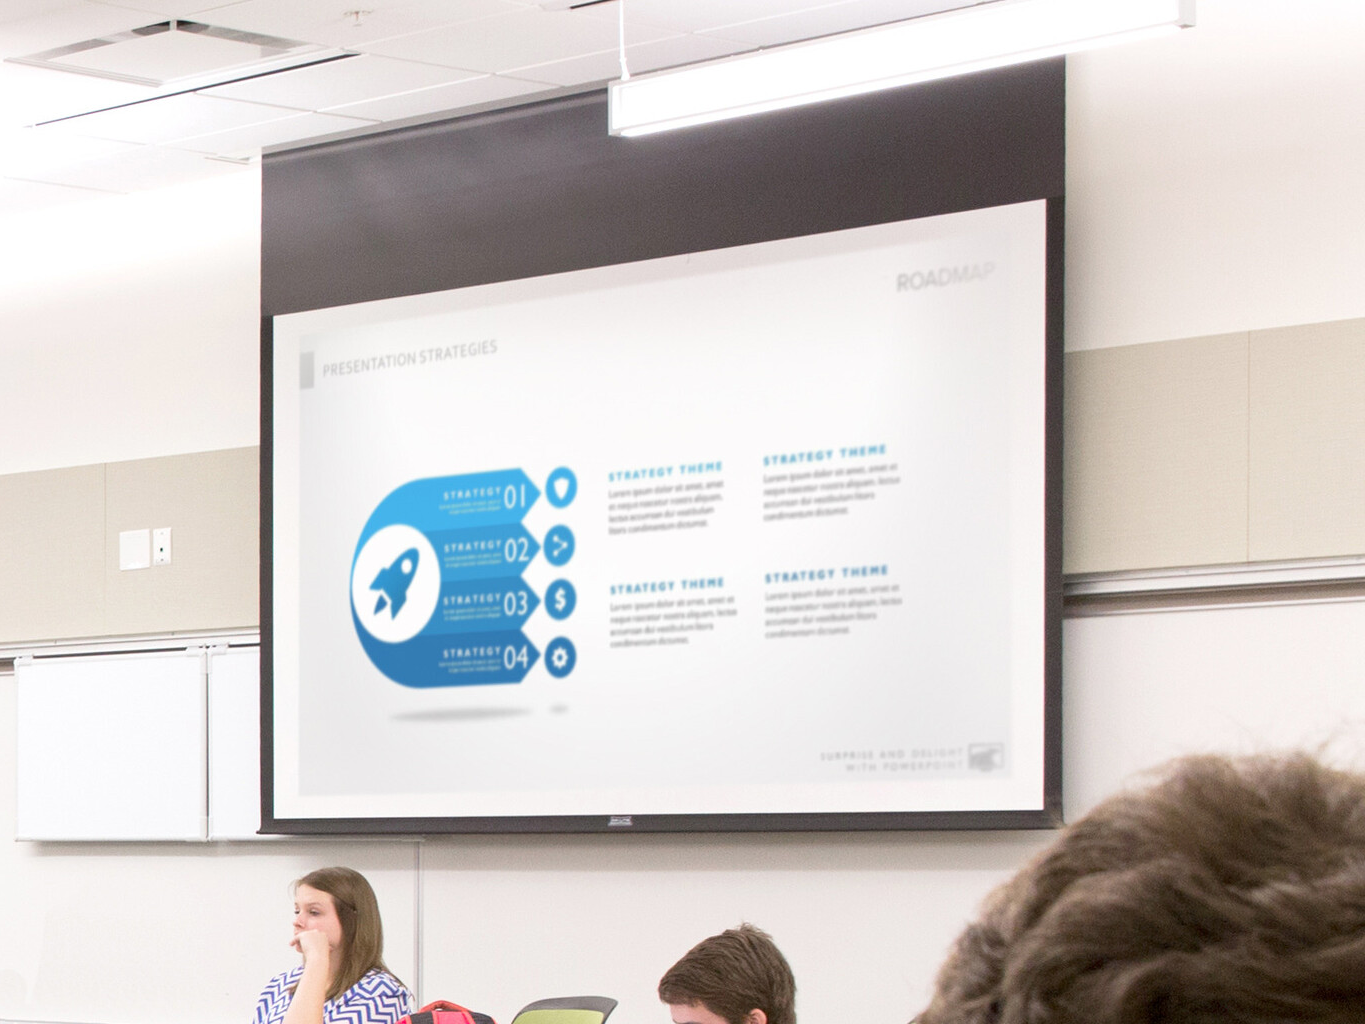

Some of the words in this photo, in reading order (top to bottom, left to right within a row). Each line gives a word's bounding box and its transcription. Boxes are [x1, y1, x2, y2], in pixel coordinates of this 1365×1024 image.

[896, 262, 995, 292] ROADMAP
[323, 352, 416, 377] PRESENTATION
[419, 339, 498, 364] STRATEGIES
[763, 449, 833, 467] STRATEGY
[840, 444, 886, 458] THEME
[608, 466, 673, 482] STRATEGY
[680, 461, 722, 474] THEME
[443, 486, 501, 501] STRATEGY
[504, 484, 525, 509] 01
[444, 540, 502, 553] STRATEGY
[505, 537, 529, 562] 02
[765, 570, 835, 583] STRATEGY
[842, 564, 888, 578] THEME
[610, 582, 675, 595] STRATEGY
[681, 577, 724, 590] THEME
[443, 593, 501, 606] STRATEGY
[504, 591, 528, 616] 03
[555, 587, 566, 611] $
[443, 646, 501, 659] STRATEGY
[504, 645, 528, 670] 04
